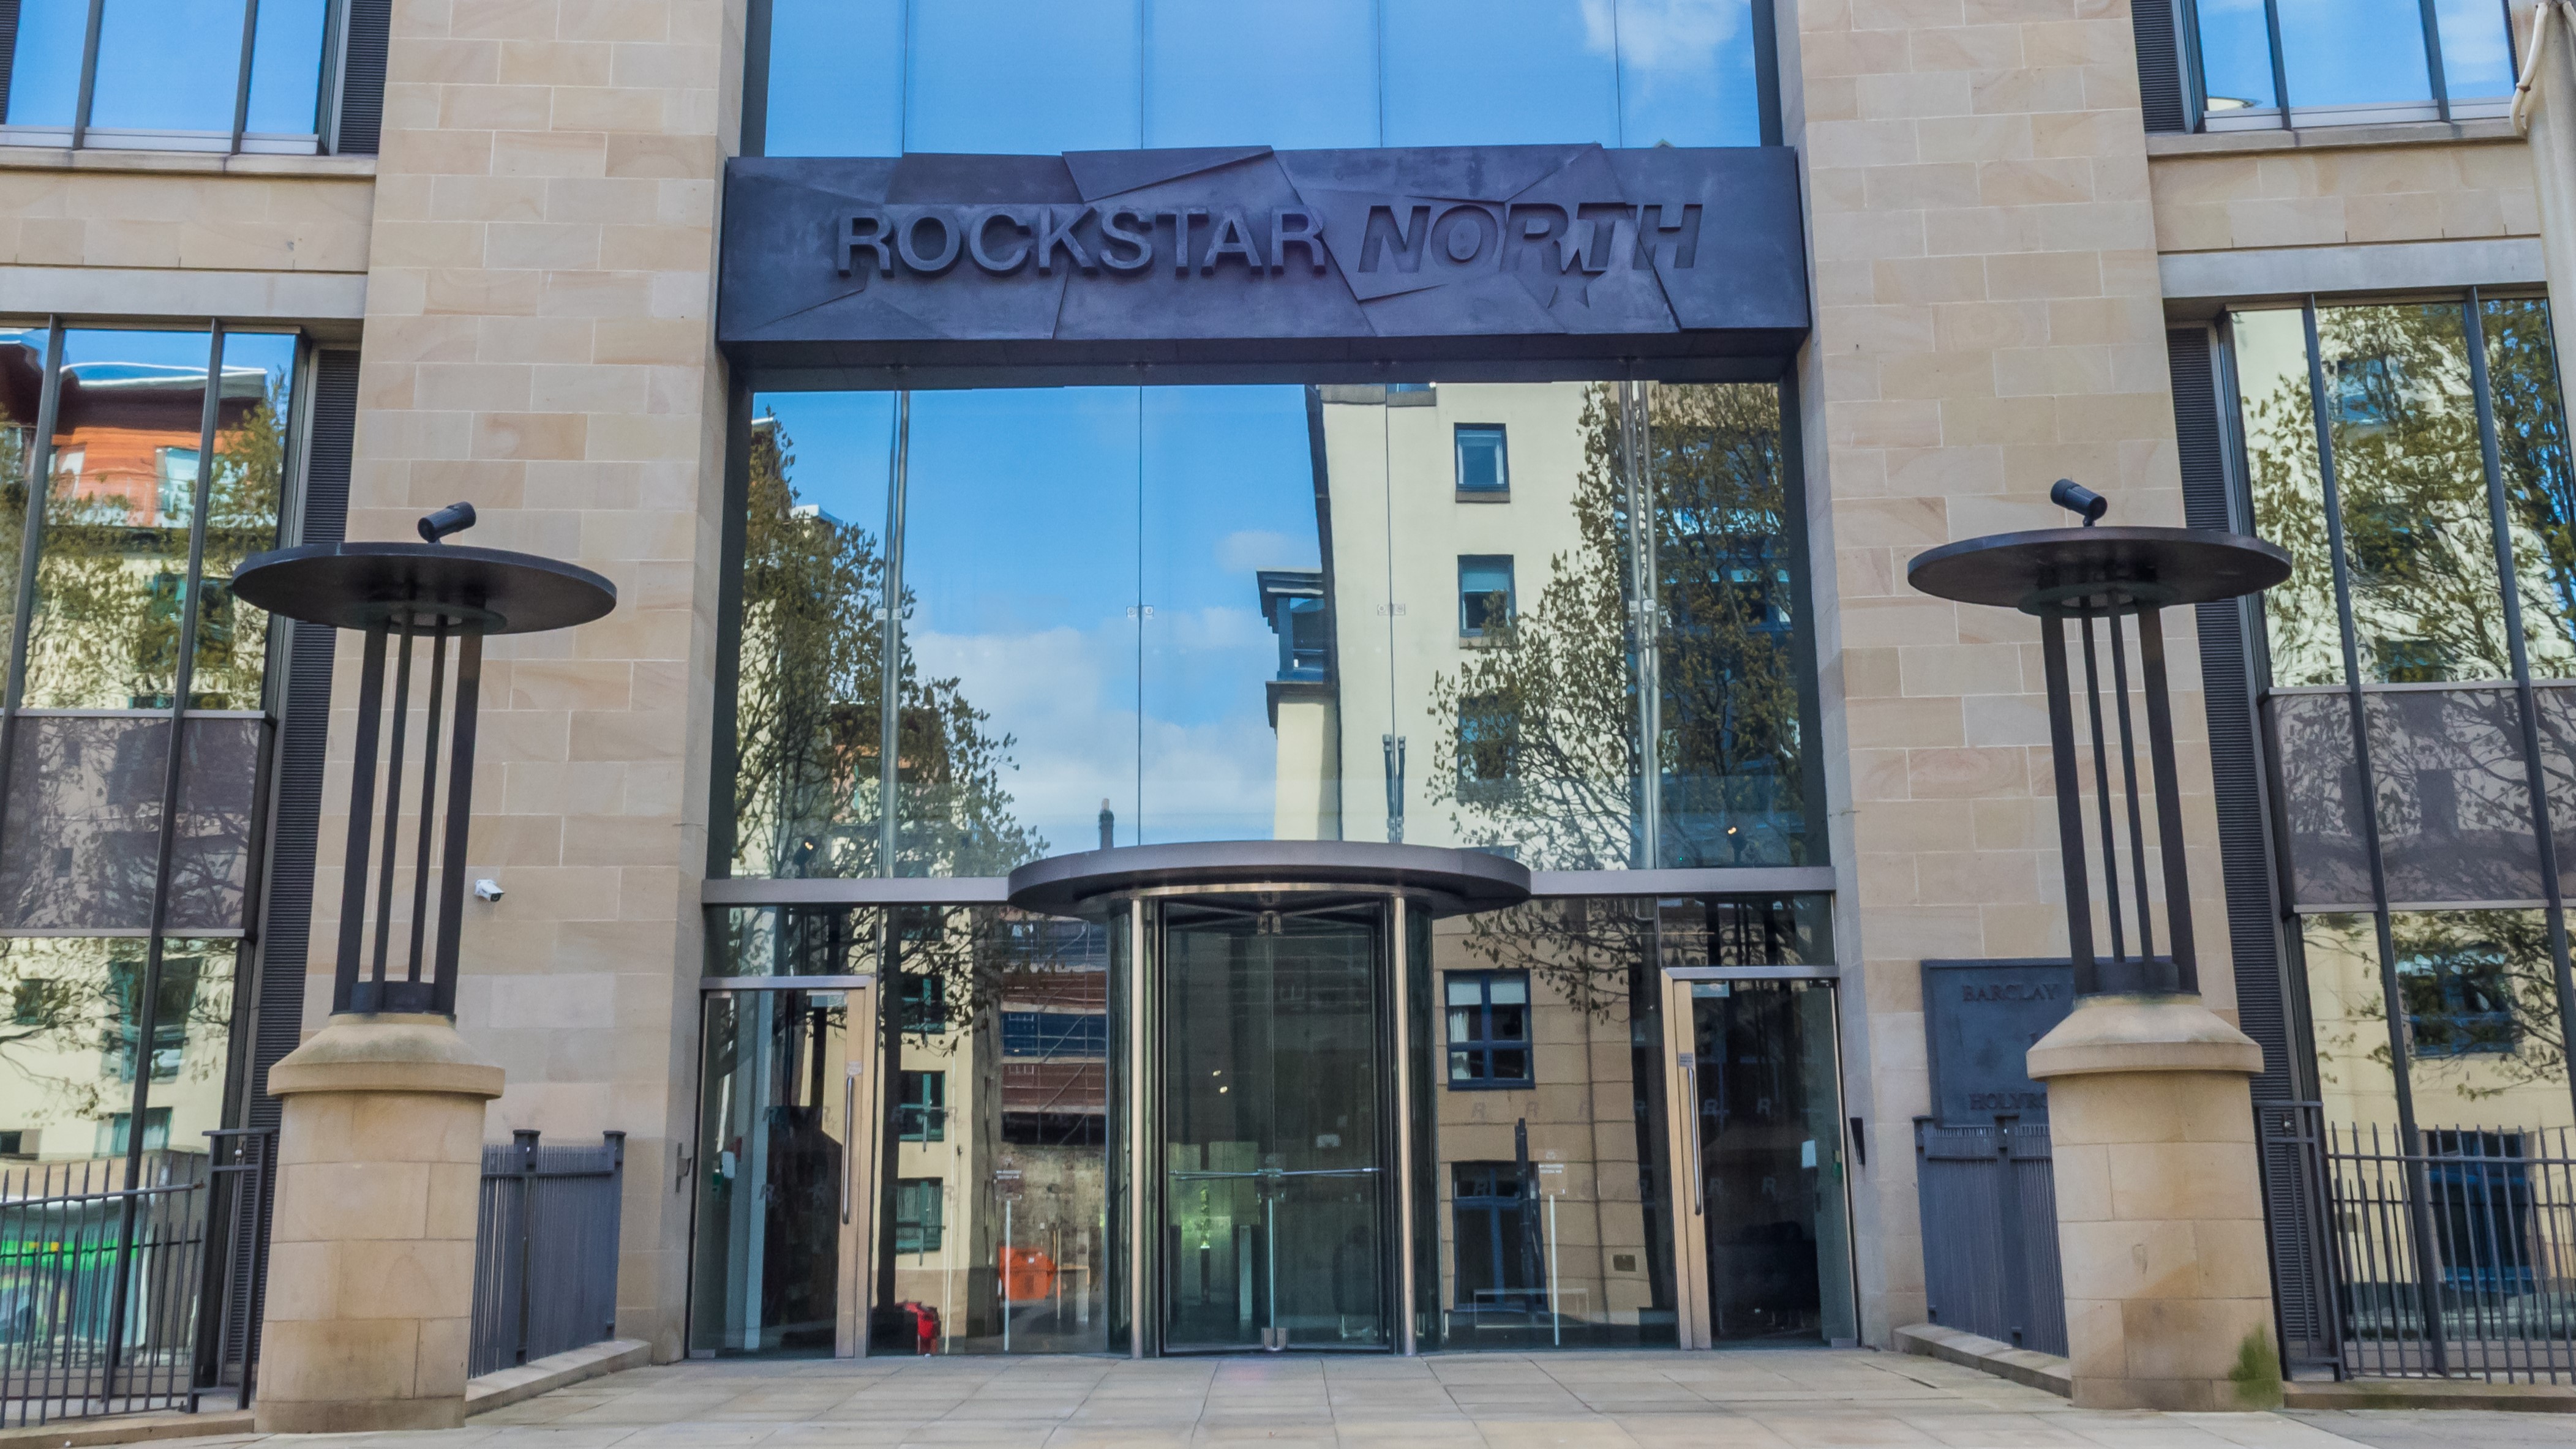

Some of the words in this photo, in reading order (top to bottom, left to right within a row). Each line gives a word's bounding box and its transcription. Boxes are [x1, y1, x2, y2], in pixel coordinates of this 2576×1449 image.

[837, 206, 1327, 277] ROCKSTAR
[1358, 202, 1703, 274] NORTH
[1962, 983, 2059, 1002] BARCLAY
